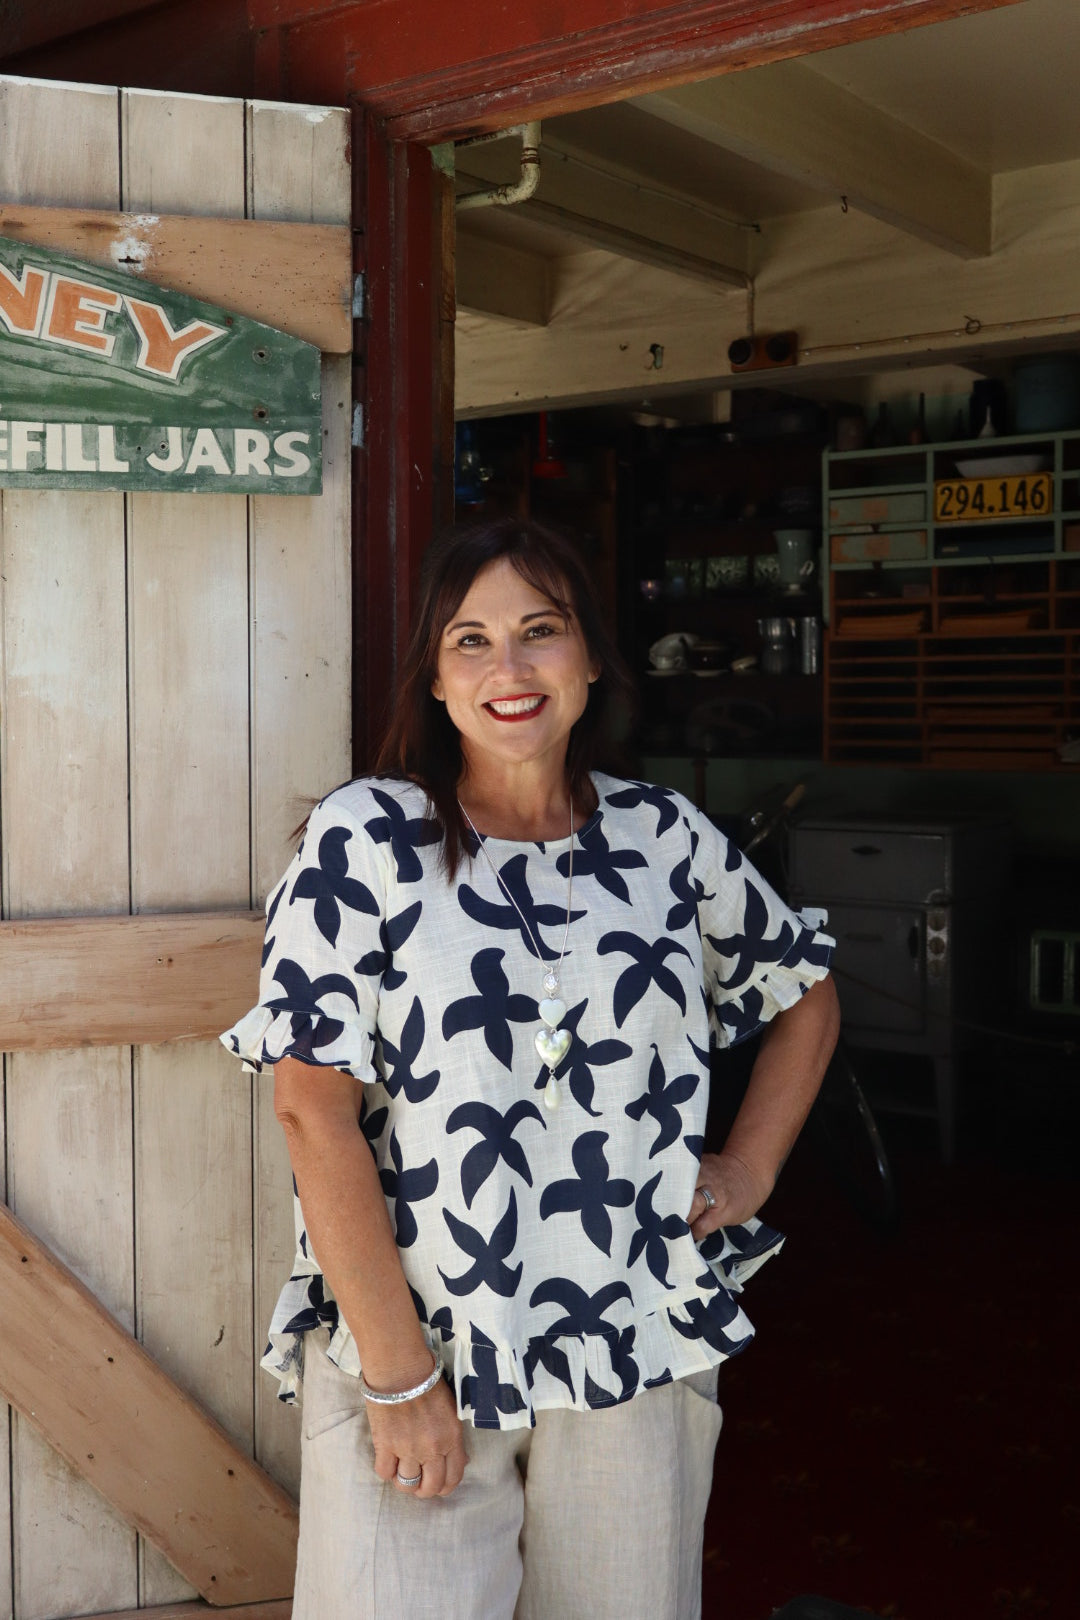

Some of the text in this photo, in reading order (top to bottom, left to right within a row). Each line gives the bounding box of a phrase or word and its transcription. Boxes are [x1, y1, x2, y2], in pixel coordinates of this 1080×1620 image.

[0, 420, 312, 477] FILL JARS
[940, 479, 1045, 517] 294.146
